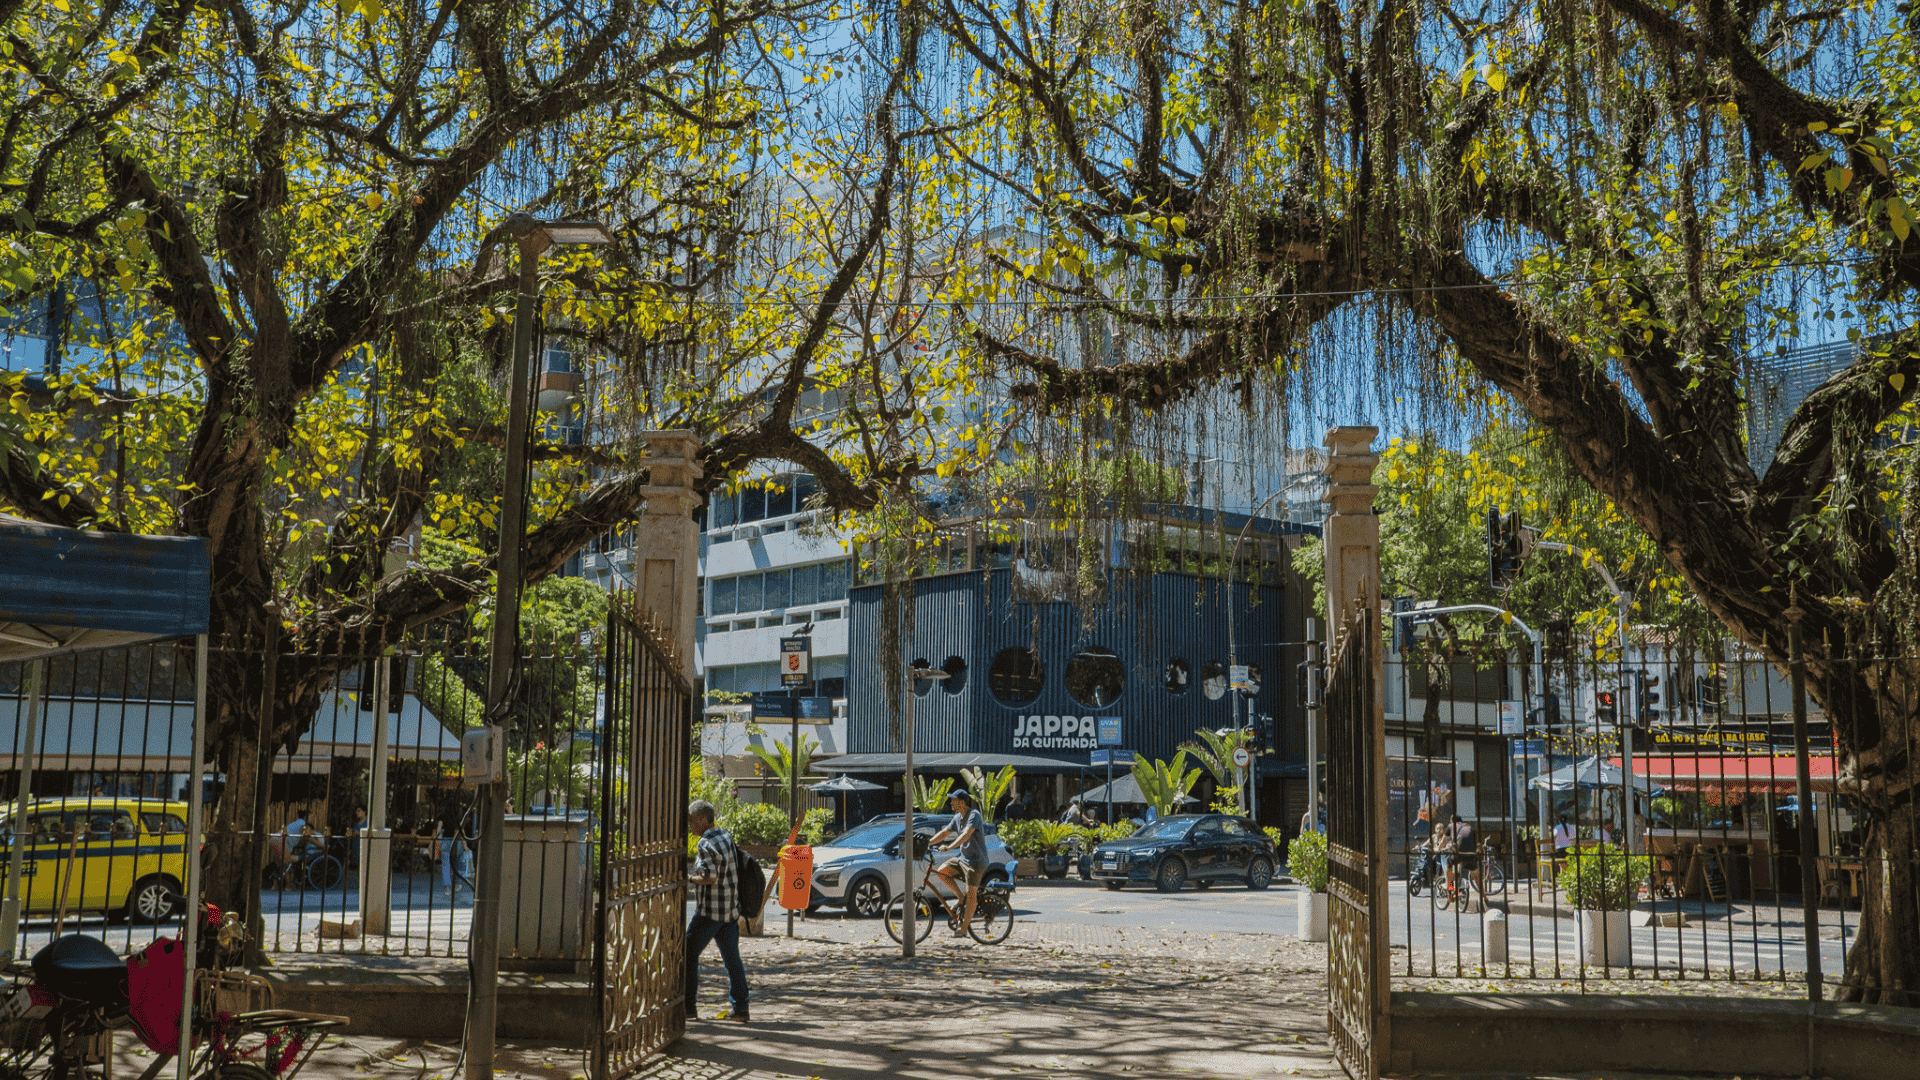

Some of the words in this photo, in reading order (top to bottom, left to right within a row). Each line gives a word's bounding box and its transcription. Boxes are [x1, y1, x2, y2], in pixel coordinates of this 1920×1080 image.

[1014, 715, 1096, 737] JAPPA
[1013, 737, 1030, 748] DA
[1032, 737, 1098, 748] QUITANDA
[1655, 734, 1683, 743] GALTO
